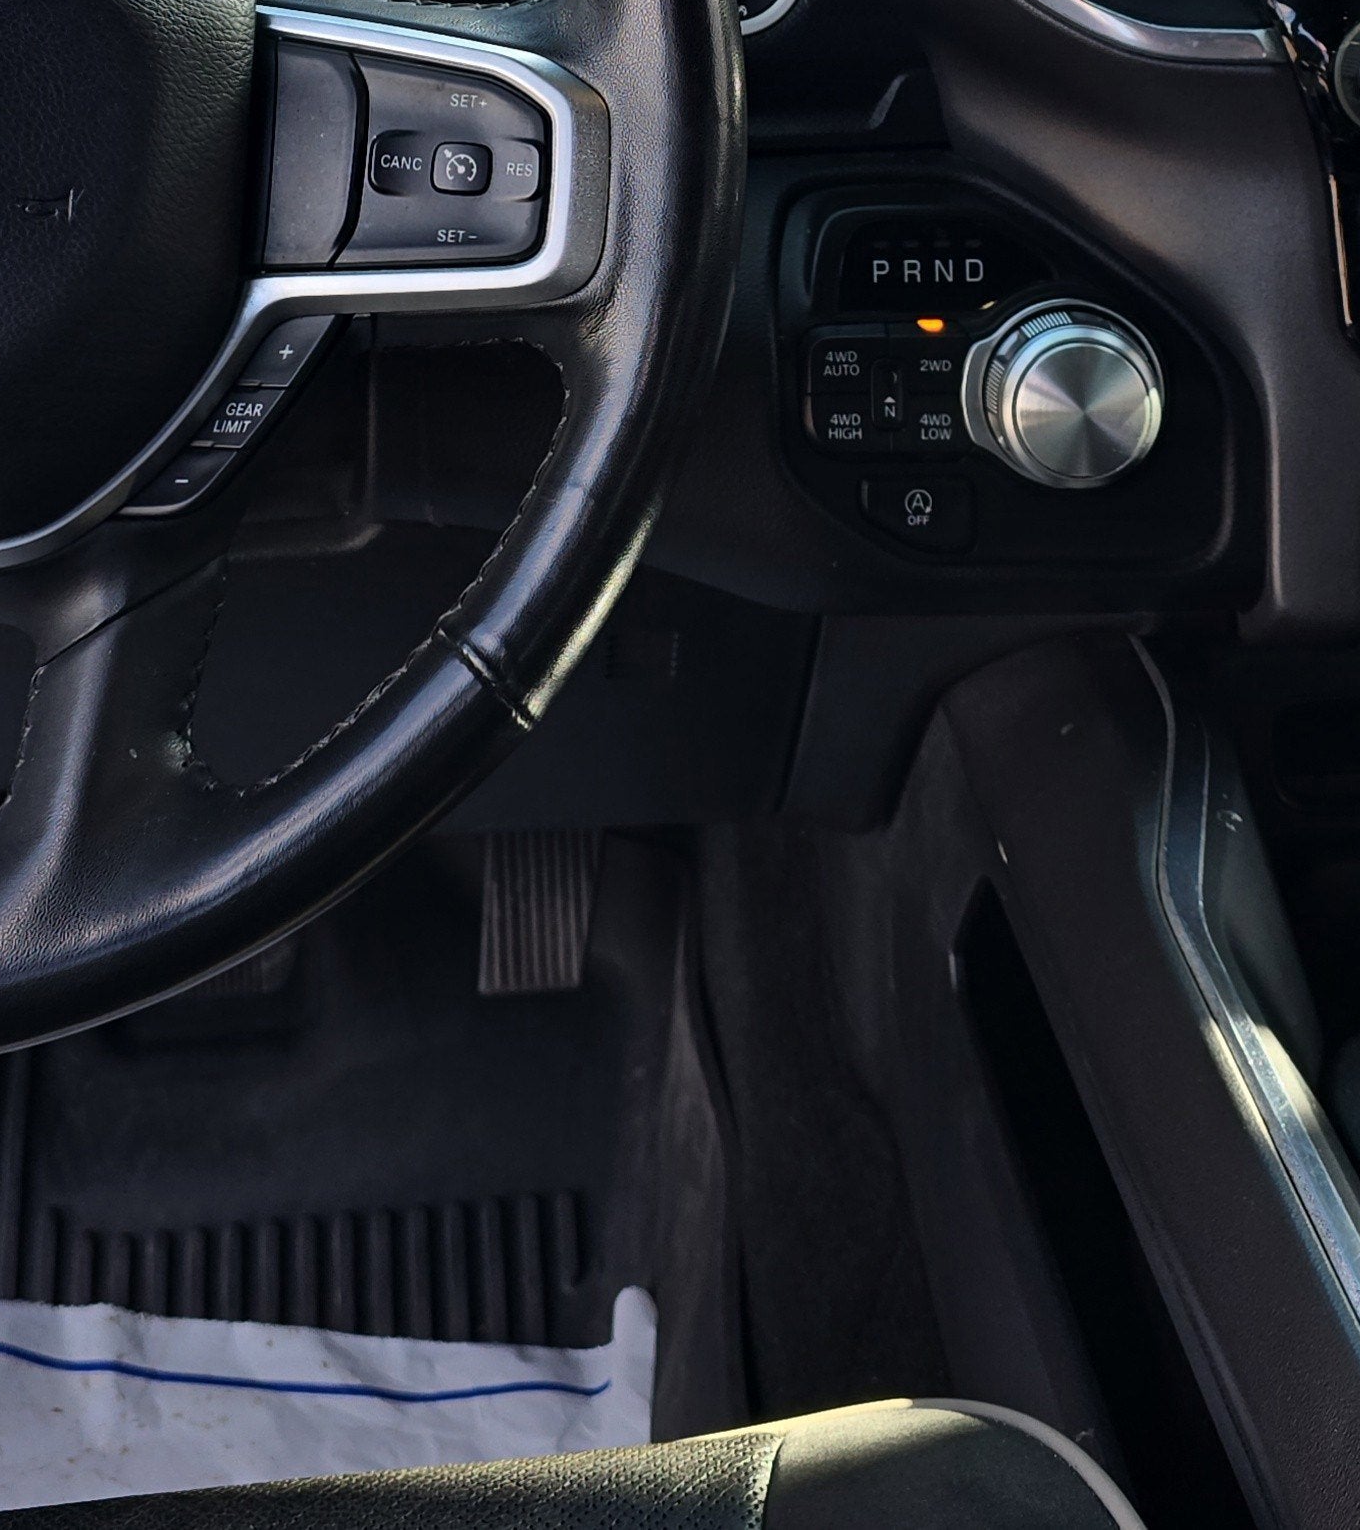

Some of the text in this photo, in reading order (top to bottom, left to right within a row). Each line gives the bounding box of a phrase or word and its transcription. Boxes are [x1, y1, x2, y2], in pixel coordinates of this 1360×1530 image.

[380, 154, 423, 171] CANC
[506, 162, 533, 177] RES
[872, 258, 984, 283] P R N D
[825, 350, 858, 363] 4WD
[823, 363, 860, 376] AUTO
[920, 359, 952, 372] 2WD
[226, 403, 263, 417] GEAR
[884, 405, 896, 418] N
[829, 413, 861, 426] 4WD
[919, 413, 952, 426] 4WD
[213, 420, 251, 433] LIMIT
[828, 428, 863, 440] HIGH
[920, 428, 952, 441] LOW
[907, 515, 931, 526] OFF
